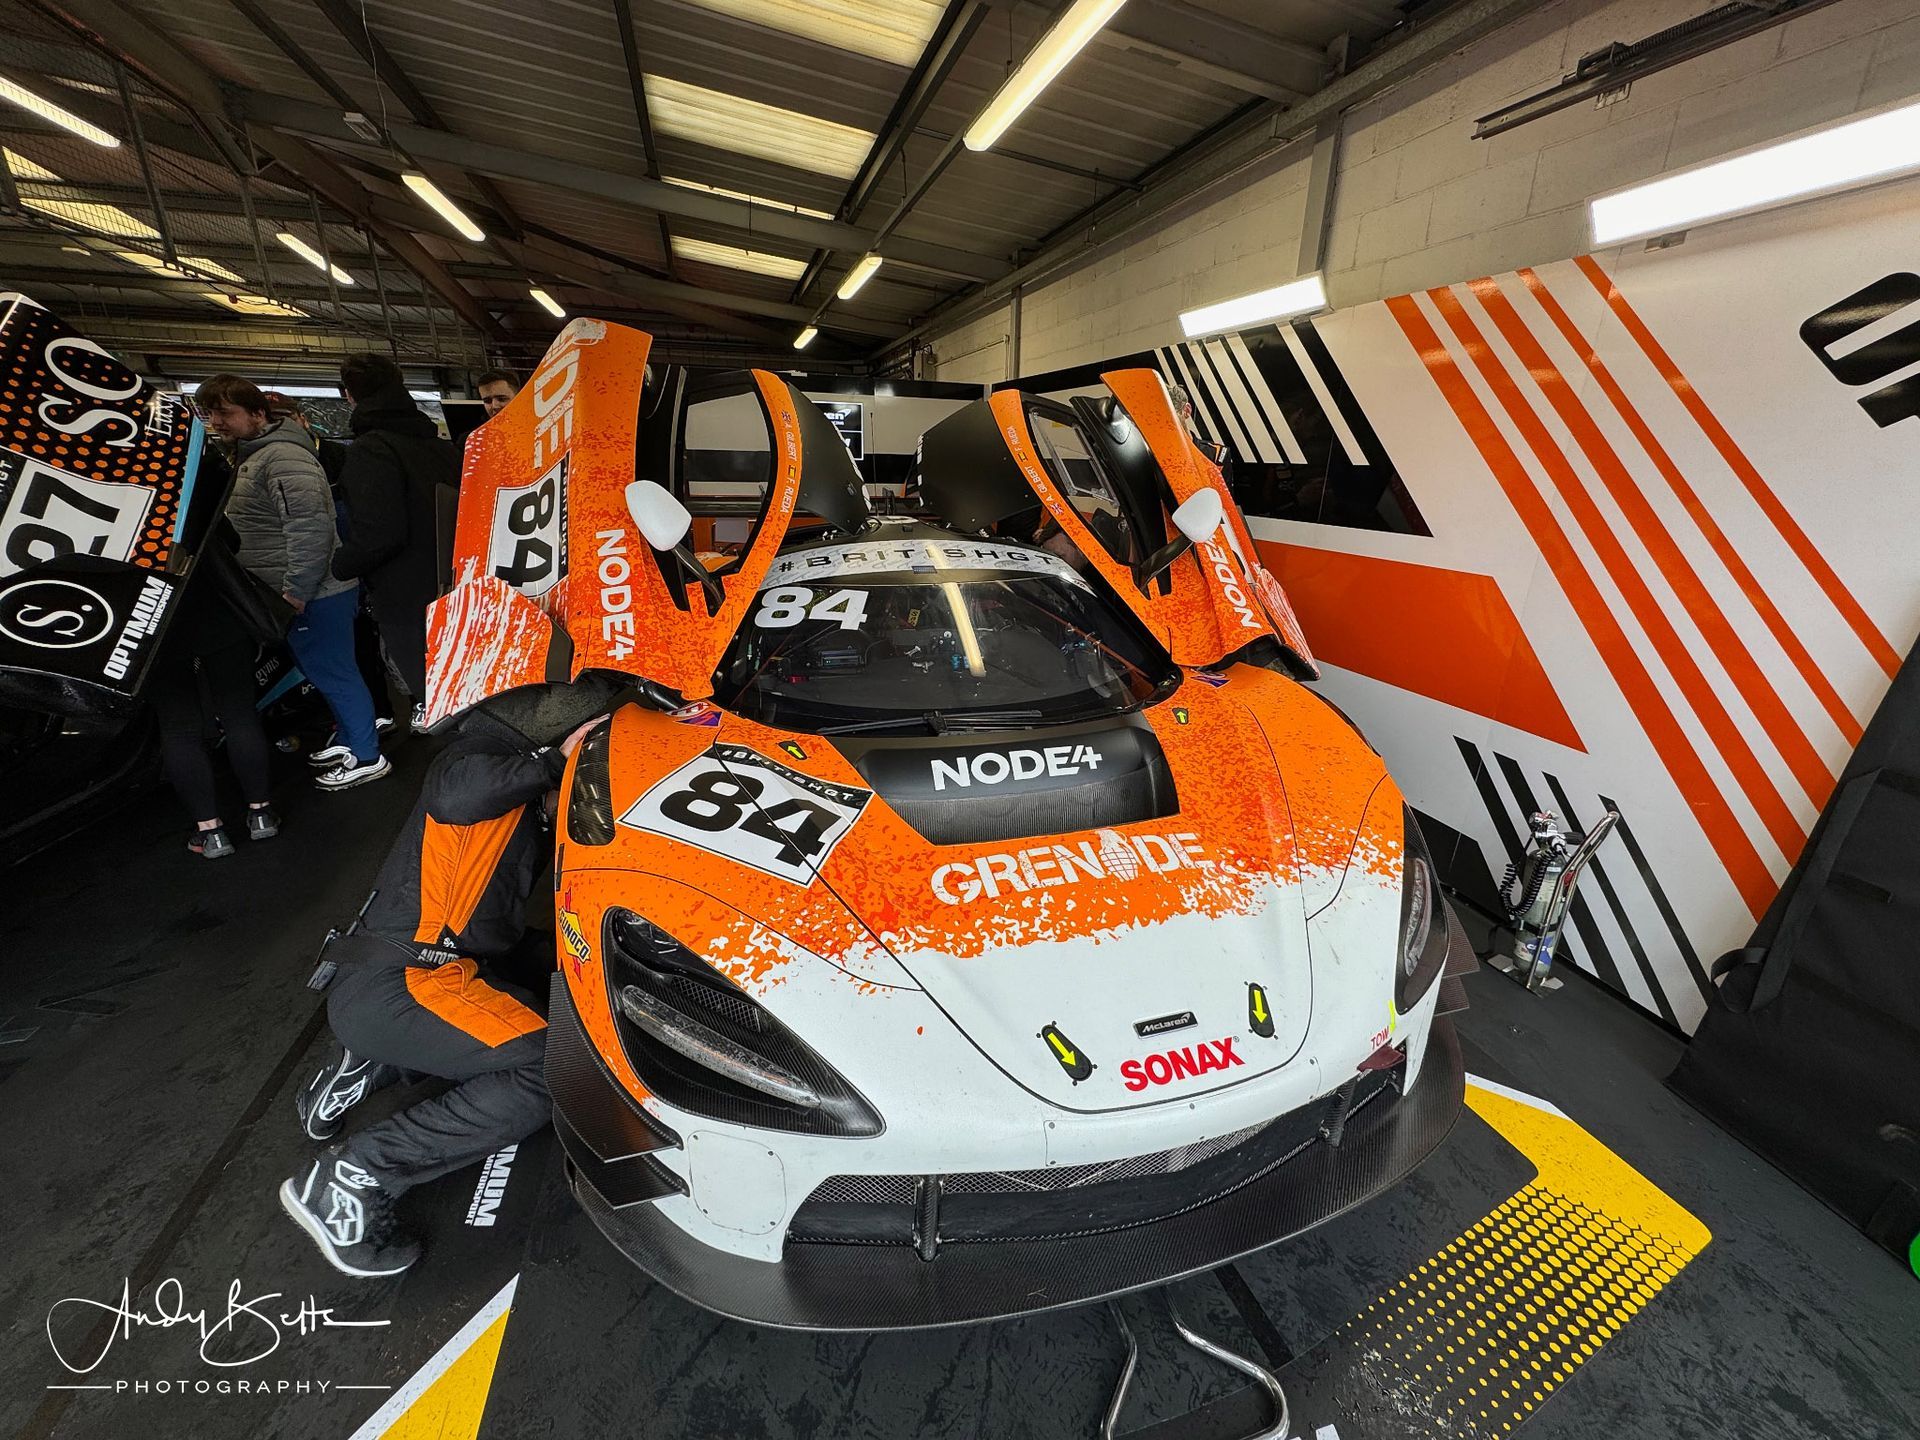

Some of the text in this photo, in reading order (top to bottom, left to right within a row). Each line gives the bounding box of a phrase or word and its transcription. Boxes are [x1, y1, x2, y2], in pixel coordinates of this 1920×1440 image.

[780, 486, 795, 513] RUEDA
[495, 477, 555, 588] 84
[778, 548, 1054, 573] #BRITISHGT
[145, 583, 174, 636] MOTORSPORT
[595, 528, 637, 662] NODE4
[754, 586, 870, 631] 84
[103, 575, 166, 680] OPTIMUM
[722, 750, 854, 801] #BRITISHGT
[931, 744, 1102, 791] NODE4
[660, 771, 842, 868] 84
[560, 911, 589, 960] SUNOCO
[1142, 1015, 1189, 1033] McLaren
[1370, 1025, 1390, 1051] TOW
[1120, 1036, 1247, 1092] SONAX
